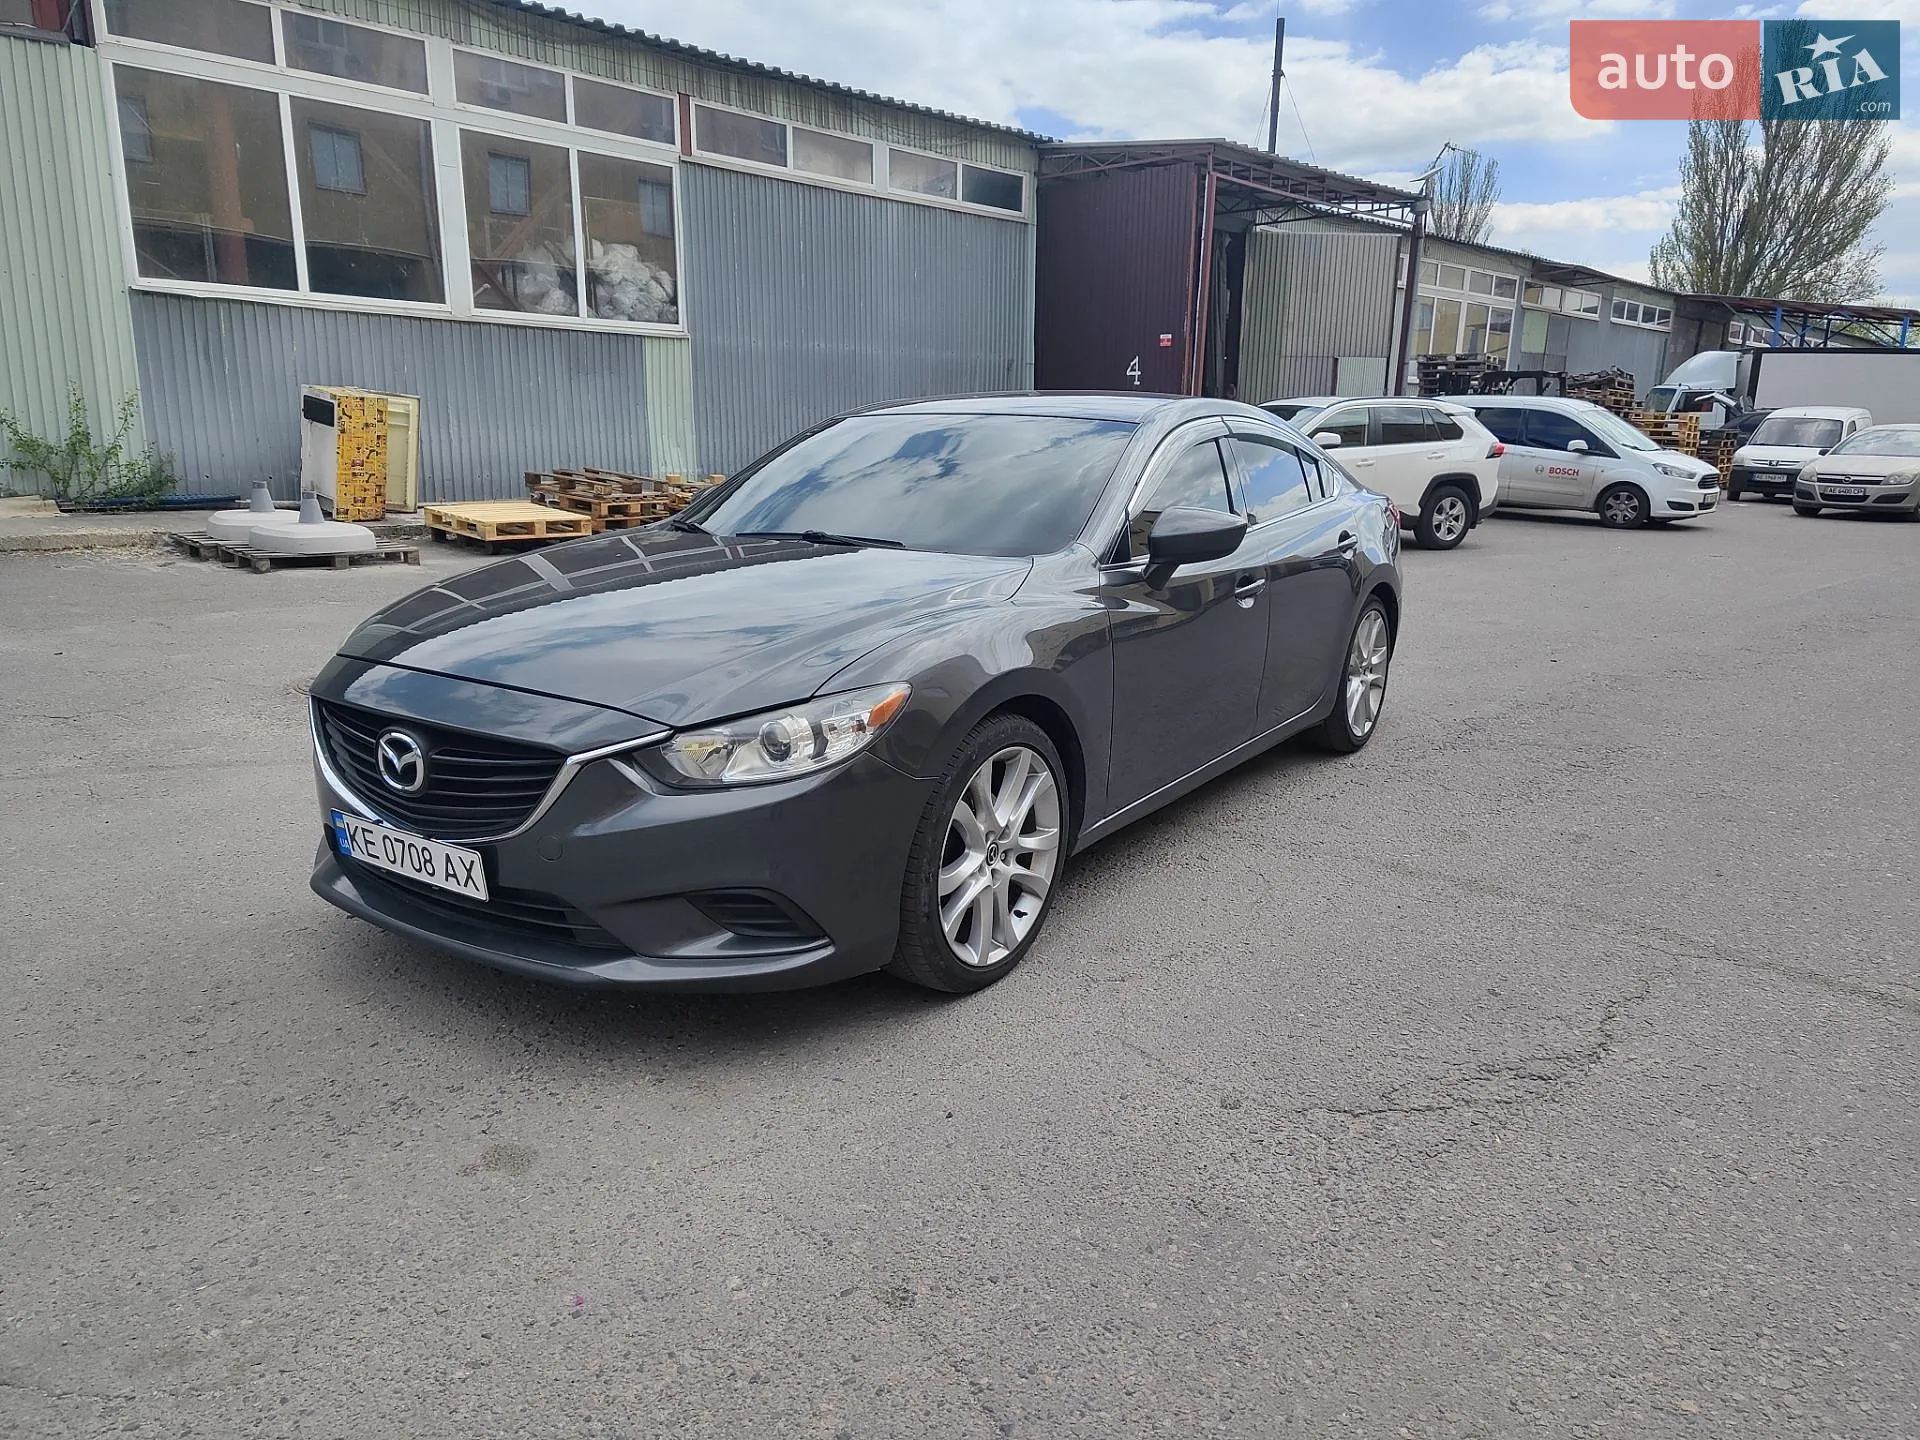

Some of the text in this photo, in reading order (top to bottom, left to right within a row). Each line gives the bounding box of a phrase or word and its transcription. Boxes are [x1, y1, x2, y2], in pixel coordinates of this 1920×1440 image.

[1126, 355, 1141, 385] 4
[1549, 466, 1579, 476] BOSCH
[339, 837, 350, 848] UA
[346, 822, 480, 892] KE 0708 AX
